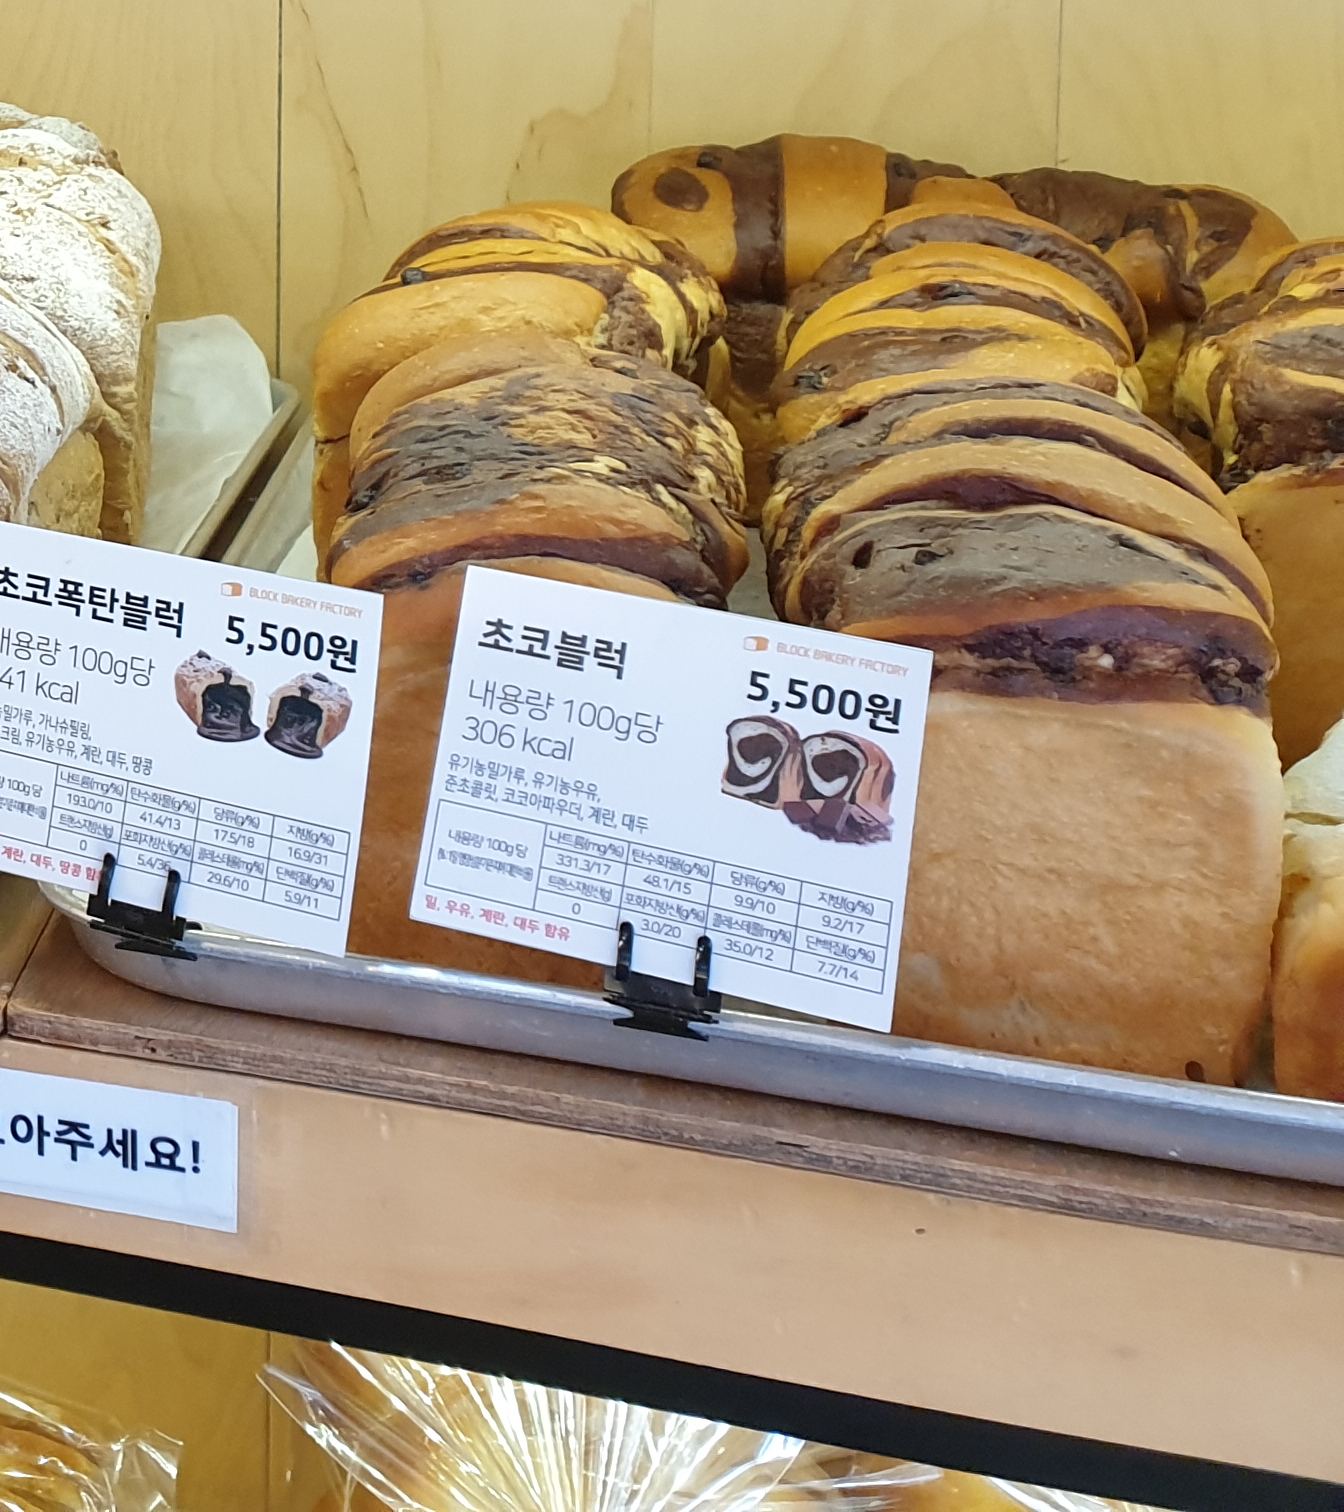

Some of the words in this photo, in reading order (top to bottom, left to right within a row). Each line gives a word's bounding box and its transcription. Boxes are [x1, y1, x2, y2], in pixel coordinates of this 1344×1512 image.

[249, 587, 279, 603] BLOCK
[281, 593, 318, 610] BAKERY
[320, 603, 363, 618] FACTORY
[225, 615, 358, 674] 5,500원
[478, 618, 627, 680] 초코블럭
[777, 642, 810, 658] BLOCK
[813, 649, 857, 666] BAKERY
[859, 658, 908, 677] FACTORY
[69, 645, 155, 687] 100g당
[35, 672, 80, 705] kcal
[747, 670, 902, 734] 5,500원
[39, 713, 92, 741] 가나슈필링,
[469, 679, 555, 721] 내용량
[563, 699, 664, 744] 100g당
[25, 731, 77, 760] 유기농우유,
[80, 744, 103, 765] 계란,
[107, 751, 129, 772] 대두,
[132, 756, 153, 776] 땅콩
[462, 716, 516, 749] 306
[522, 727, 574, 761] kcal
[448, 753, 528, 787] 유기농밀가루,
[532, 771, 601, 803] 유기농우유,
[502, 787, 584, 821] 코코아파우더,
[588, 806, 617, 829] 계란,
[621, 813, 649, 834] 대두
[80, 840, 87, 851] 0
[556, 854, 611, 875] 331.3/17
[643, 874, 692, 895] 48.1/15
[572, 903, 581, 914] 0
[734, 894, 776, 914] 9.9/10
[641, 918, 682, 939] 3.0/20
[821, 915, 865, 935] 9.2/17
[724, 939, 774, 962] 35.0/12
[817, 960, 859, 982] 7.7/14
